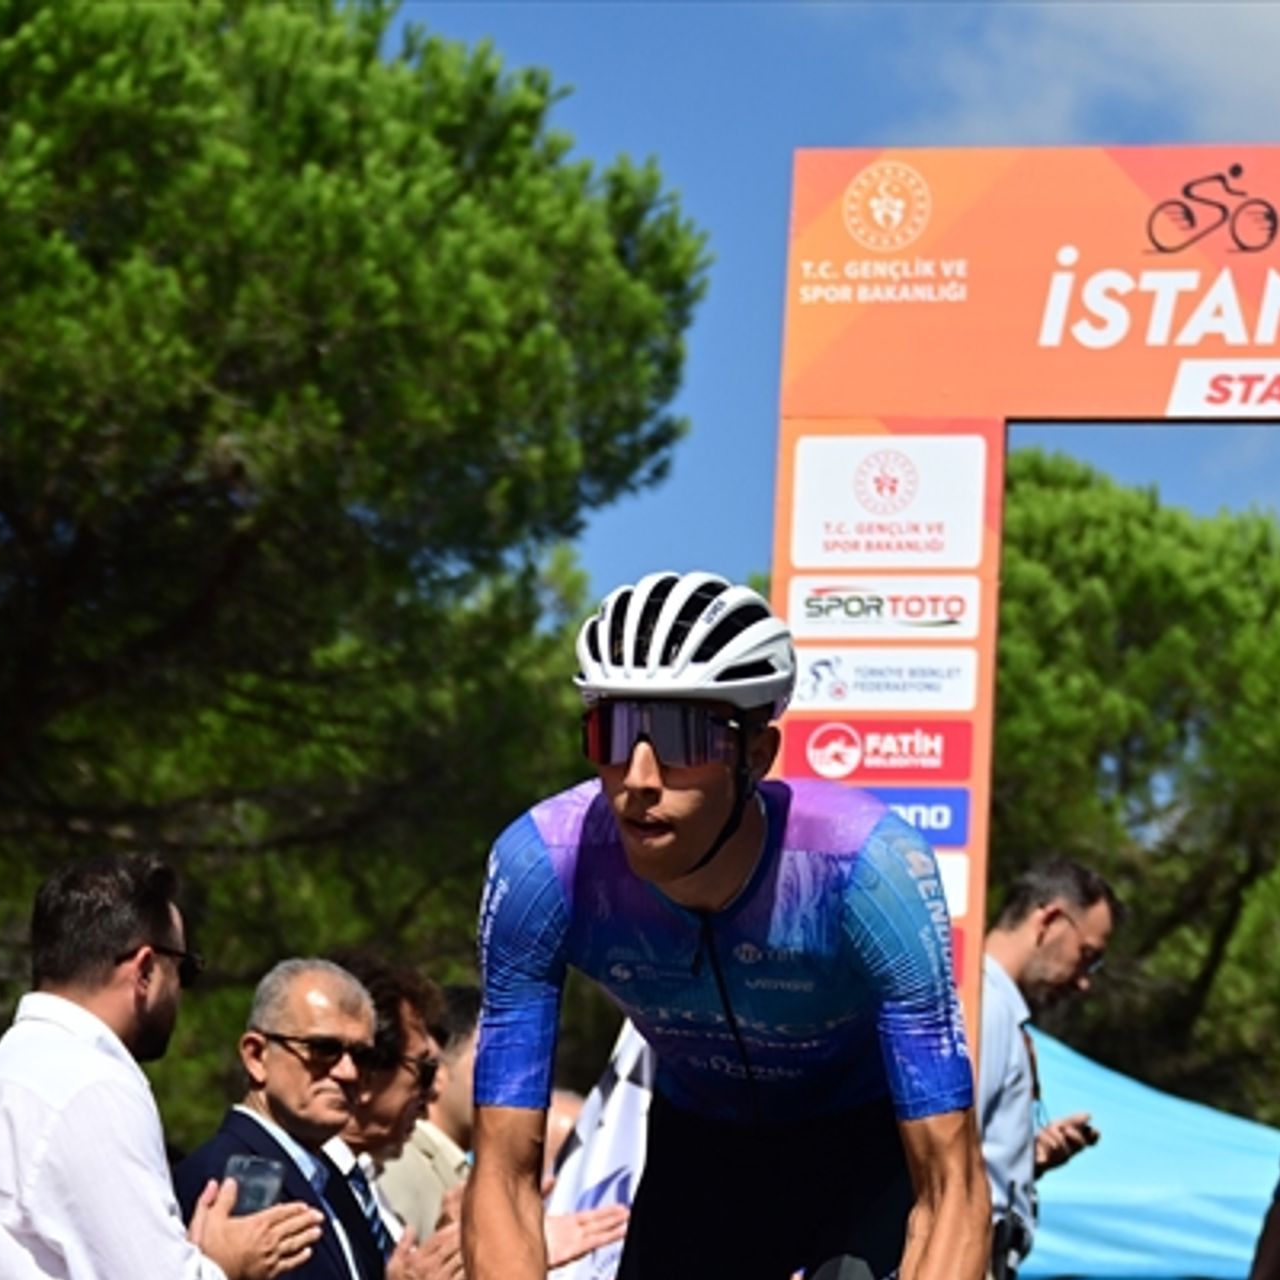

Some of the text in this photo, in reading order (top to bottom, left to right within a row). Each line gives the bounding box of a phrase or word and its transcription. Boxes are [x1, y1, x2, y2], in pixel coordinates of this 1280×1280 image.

[800, 256, 967, 282] T.C. GENÇLİK VE
[799, 280, 967, 304] SPOR BAKANLIĞI
[926, 521, 945, 534] VE
[823, 540, 860, 553] SPOR
[865, 729, 944, 756] FATİH
